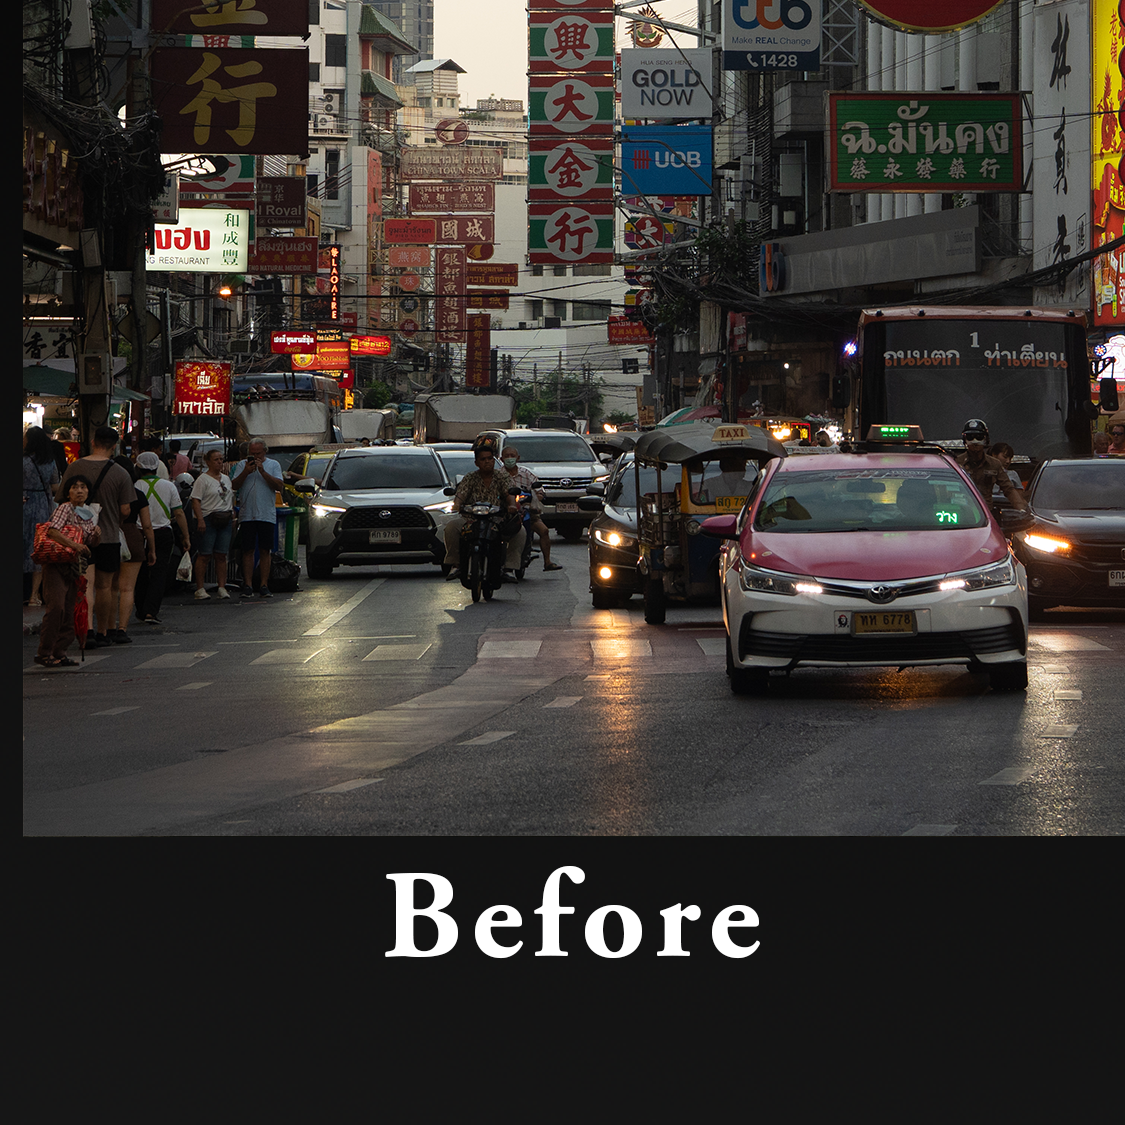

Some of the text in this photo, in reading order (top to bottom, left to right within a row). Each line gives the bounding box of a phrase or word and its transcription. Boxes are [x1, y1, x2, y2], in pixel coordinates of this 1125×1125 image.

[731, 36, 811, 46] Make REAL Change
[760, 54, 798, 67] 1428
[632, 68, 701, 88] GOLD
[640, 88, 694, 106] NOW
[841, 100, 1009, 154] ฉ.มั่นคง
[654, 150, 702, 169] UOB
[407, 167, 497, 175] CHINA TOWN SCALA
[266, 204, 302, 217] Royal
[441, 218, 486, 241] 國城
[154, 227, 210, 251] งฮง
[158, 257, 210, 265] RESTAURANT
[260, 264, 284, 272] NATURAL
[969, 331, 980, 348] 1
[883, 342, 1069, 369] ถนนตก ท่าเตียน
[178, 396, 225, 414] เกาลัด
[719, 428, 745, 438] TAXI
[935, 511, 958, 524] ว่าง
[883, 614, 911, 625] 6778
